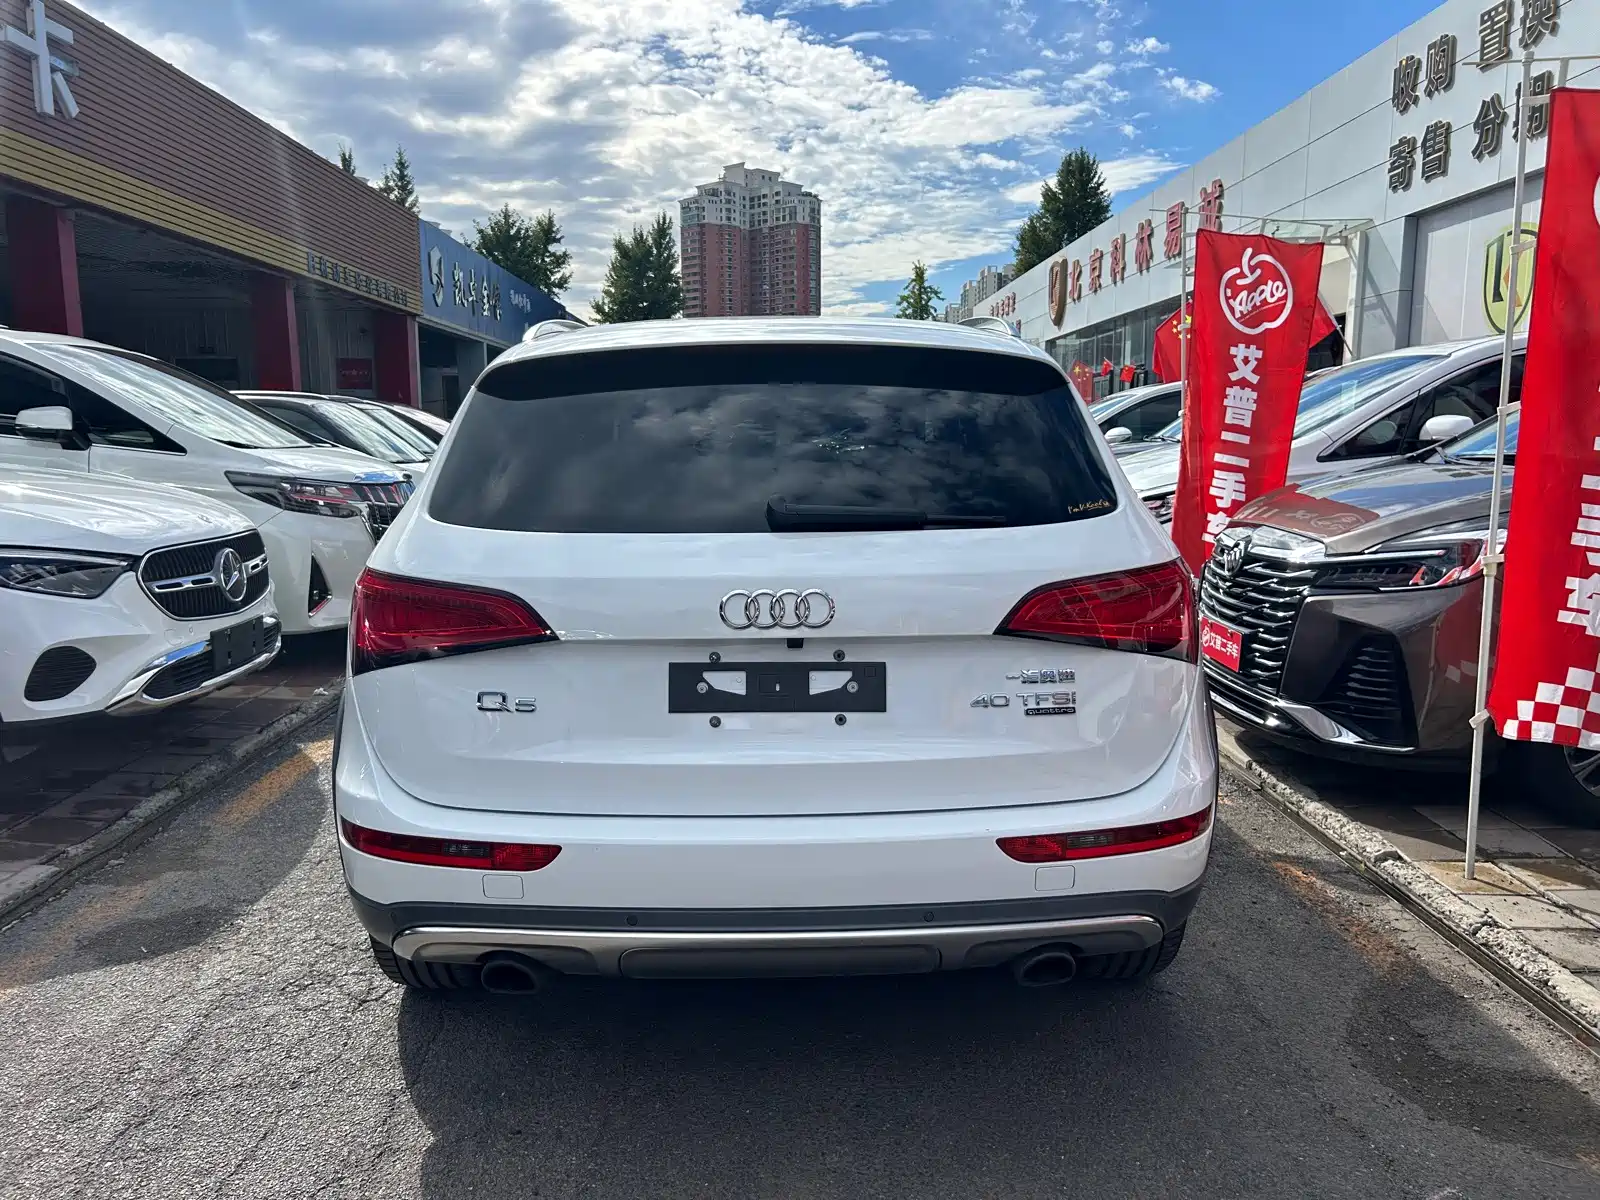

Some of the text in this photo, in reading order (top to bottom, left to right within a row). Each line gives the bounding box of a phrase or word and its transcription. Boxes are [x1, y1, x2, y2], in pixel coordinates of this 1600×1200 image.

[1391, 0, 1560, 116] 收购 置换
[1387, 120, 1451, 192] 寄售
[476, 691, 537, 713] Q5
[970, 690, 1077, 708] 40 TFSI
[1024, 706, 1077, 717] quattro
